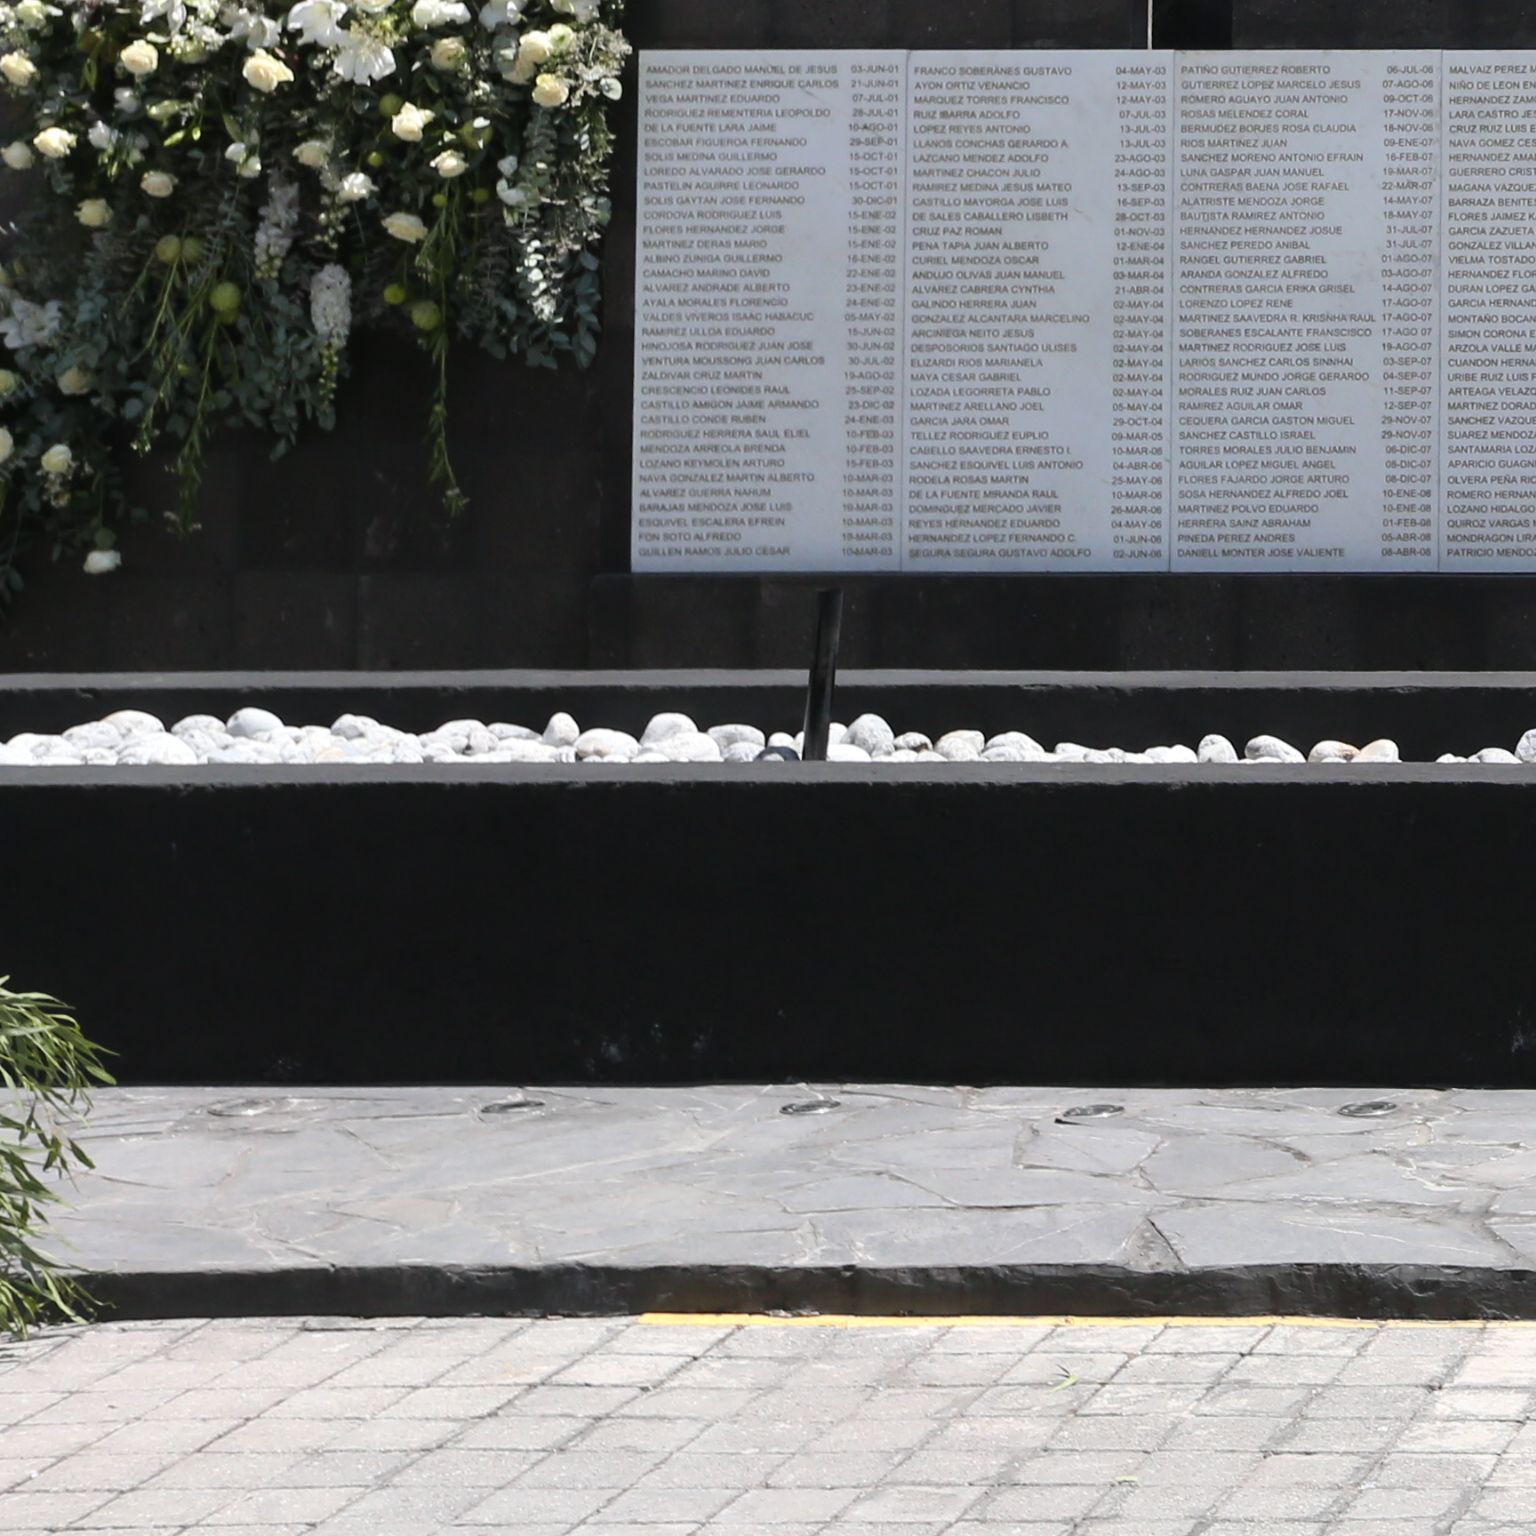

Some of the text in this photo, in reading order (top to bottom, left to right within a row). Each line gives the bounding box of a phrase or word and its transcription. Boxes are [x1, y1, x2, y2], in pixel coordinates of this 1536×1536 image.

[913, 81, 944, 90] AYON
[944, 81, 977, 90] ORTIZ
[977, 81, 1032, 90] VENANCIO
[1448, 78, 1475, 90] NIÑO
[1475, 80, 1491, 90] DE
[1492, 80, 1521, 90] LEON
[1447, 124, 1478, 134] CRUZ
[1478, 124, 1504, 134] RUIZ
[1504, 124, 1528, 134] LUIS
[1179, 139, 1206, 148] RIOS
[1206, 139, 1260, 148] MARTINEZ
[1260, 139, 1288, 148] JUAN
[912, 154, 961, 163] LAZCANO
[962, 154, 1006, 163] MENDEZ
[1006, 154, 1050, 163] ADOLFO
[1179, 197, 1236, 207] ALATRISTE
[1237, 197, 1289, 207] MENDOZA
[1289, 197, 1325, 207] JORGE
[911, 226, 941, 236] CRUZ
[942, 226, 963, 236] PAZ
[964, 226, 1003, 236] ROMAN
[1178, 226, 1243, 236] HERNANDEZ
[1243, 226, 1308, 236] HERNANDEZ
[1308, 226, 1343, 236] JOSUE
[1447, 226, 1488, 236] GARCIA
[1488, 226, 1536, 236] ZAZUETA
[1446, 284, 1484, 294] DURAN
[1484, 284, 1520, 294] LOPEZ
[1178, 401, 1224, 411] RAMIREZ
[1225, 401, 1271, 411] AGUILAR
[1271, 401, 1304, 411] OMAR
[909, 417, 950, 426] GARCIA
[950, 417, 978, 426] JARA
[978, 417, 1010, 426] OMAR
[909, 431, 948, 441] TELLEZ
[948, 431, 1011, 441] RODRIGUEZ
[1011, 431, 1050, 441] EUPLIO
[1178, 430, 1228, 440] SANCHEZ
[1228, 430, 1279, 440] CASTILLO
[1279, 430, 1316, 440] ISRAEL
[1446, 475, 1489, 485] OLVERA
[1489, 473, 1519, 485] PEÑA
[1446, 504, 1489, 514] LOZANO
[1489, 504, 1536, 514] HIDALGO
